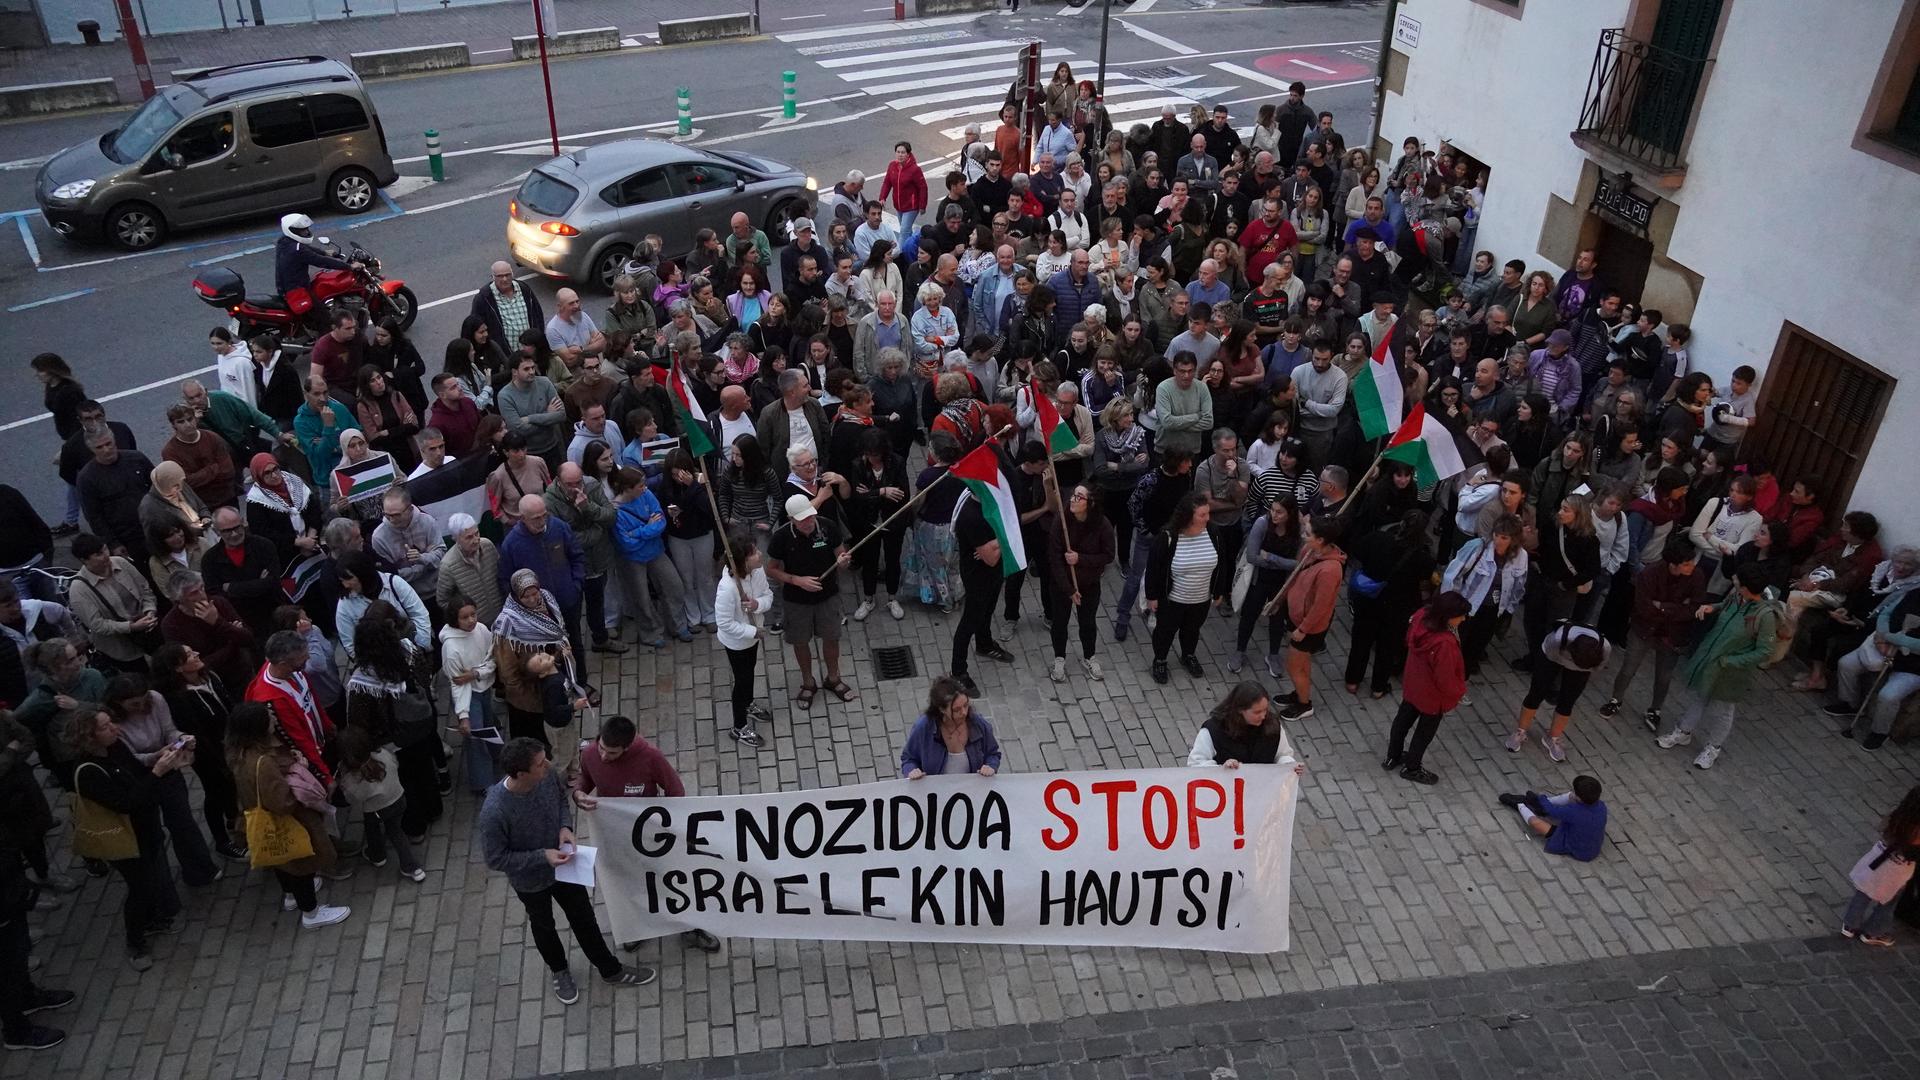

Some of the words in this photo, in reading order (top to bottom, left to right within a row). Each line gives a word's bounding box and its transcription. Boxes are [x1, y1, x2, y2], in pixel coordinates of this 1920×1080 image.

[632, 790, 1010, 862] GENOZIDIOA
[1041, 778, 1245, 851] STOP!
[646, 865, 1004, 926] ISRAELEKIN
[1040, 867, 1244, 931] HAUTSI
